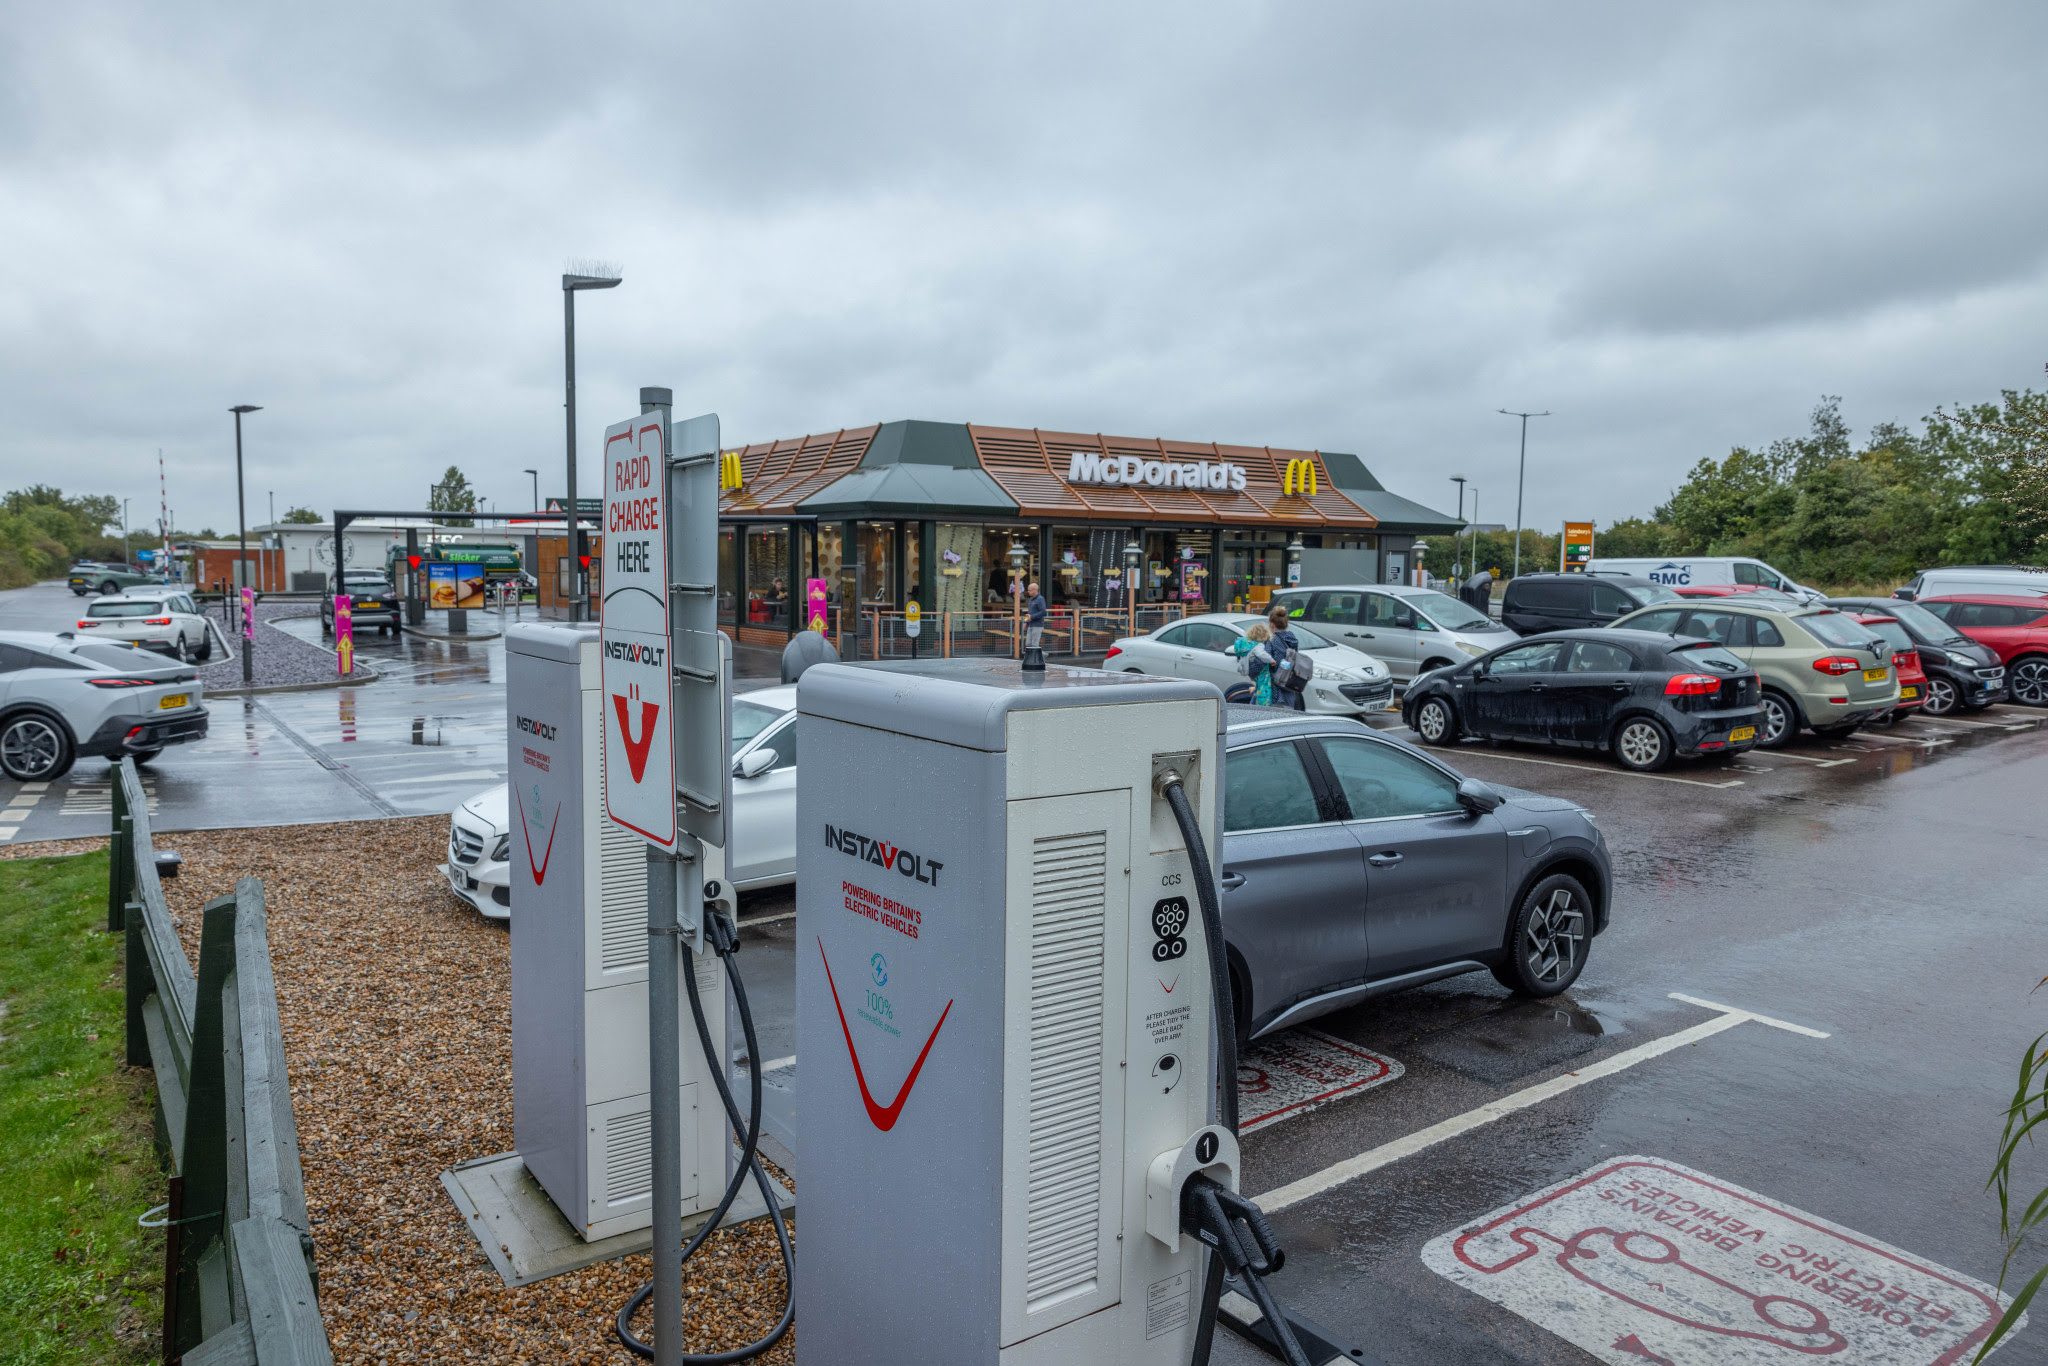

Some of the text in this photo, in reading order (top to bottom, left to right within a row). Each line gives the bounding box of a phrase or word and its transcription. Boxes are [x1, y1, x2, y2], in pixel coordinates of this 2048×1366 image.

[615, 455, 651, 493] RAPID
[1068, 452, 1247, 490] McDonald's
[609, 497, 659, 533] CHARGE
[617, 541, 650, 573] HERE
[1649, 572, 1691, 585] BMC
[604, 640, 665, 667] INSTAVOLT
[516, 715, 558, 741] INSTAVOLT
[825, 823, 944, 887] INSTAVOLT
[709, 883, 716, 896] 1
[1161, 873, 1182, 887] CCS
[842, 880, 922, 925] POWERING BRITAIN'S
[844, 896, 919, 939] ELECTRIC VEHICLES
[865, 989, 894, 1020] 100%
[1145, 1006, 1191, 1021] AFTER CHARGING
[1145, 1013, 1190, 1029] PLEASE TIDY THE
[1152, 1023, 1184, 1037] CABLE BACK
[1154, 1032, 1182, 1044] OVER ARM
[1203, 1137, 1210, 1158] 1
[1600, 1188, 1939, 1339] POWERING BRITAIN'S
[1623, 1179, 1954, 1323] ELECTRIC VEHICLES
